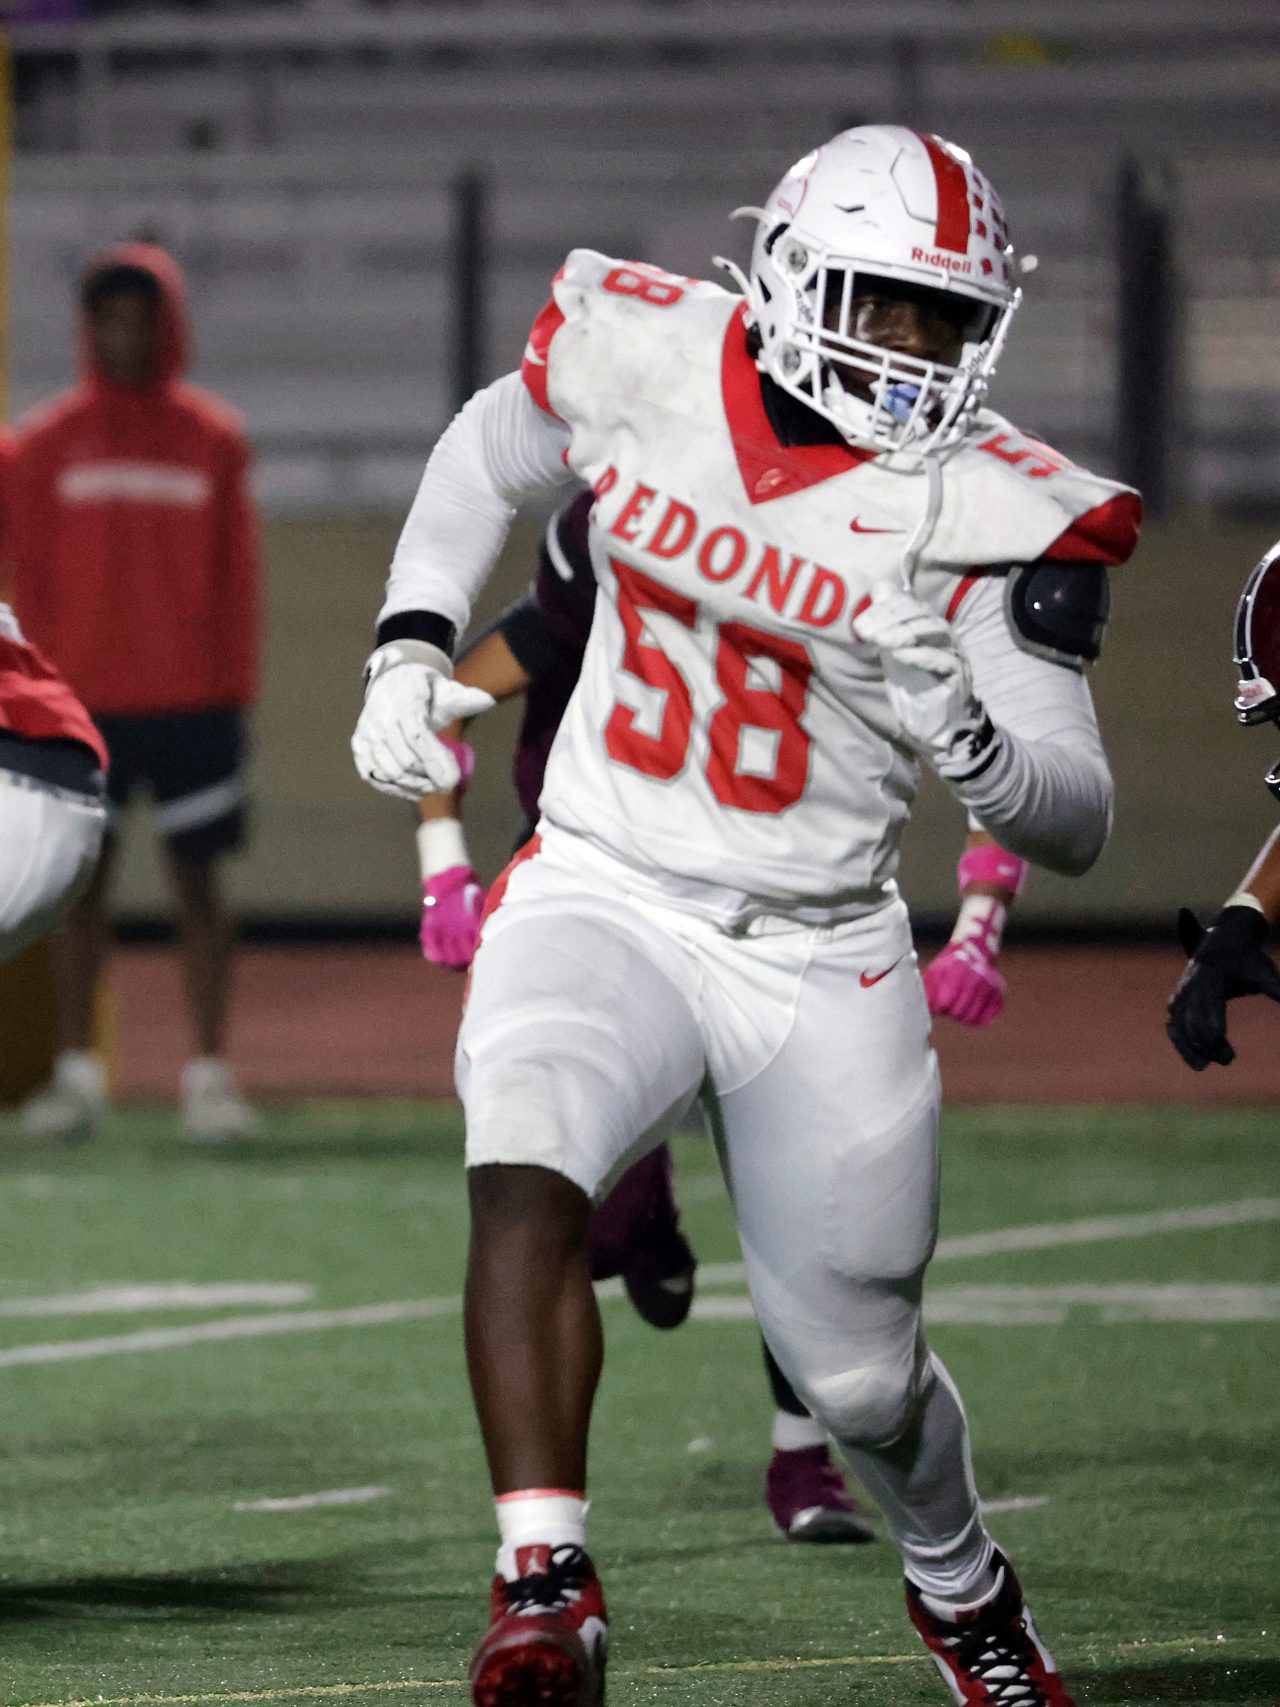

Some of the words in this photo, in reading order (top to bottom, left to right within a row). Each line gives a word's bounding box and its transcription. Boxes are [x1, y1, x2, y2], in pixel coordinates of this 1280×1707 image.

[602, 262, 686, 307] 8
[911, 246, 973, 273] Riddell
[594, 465, 873, 642] REDOND
[603, 554, 815, 817] 58
